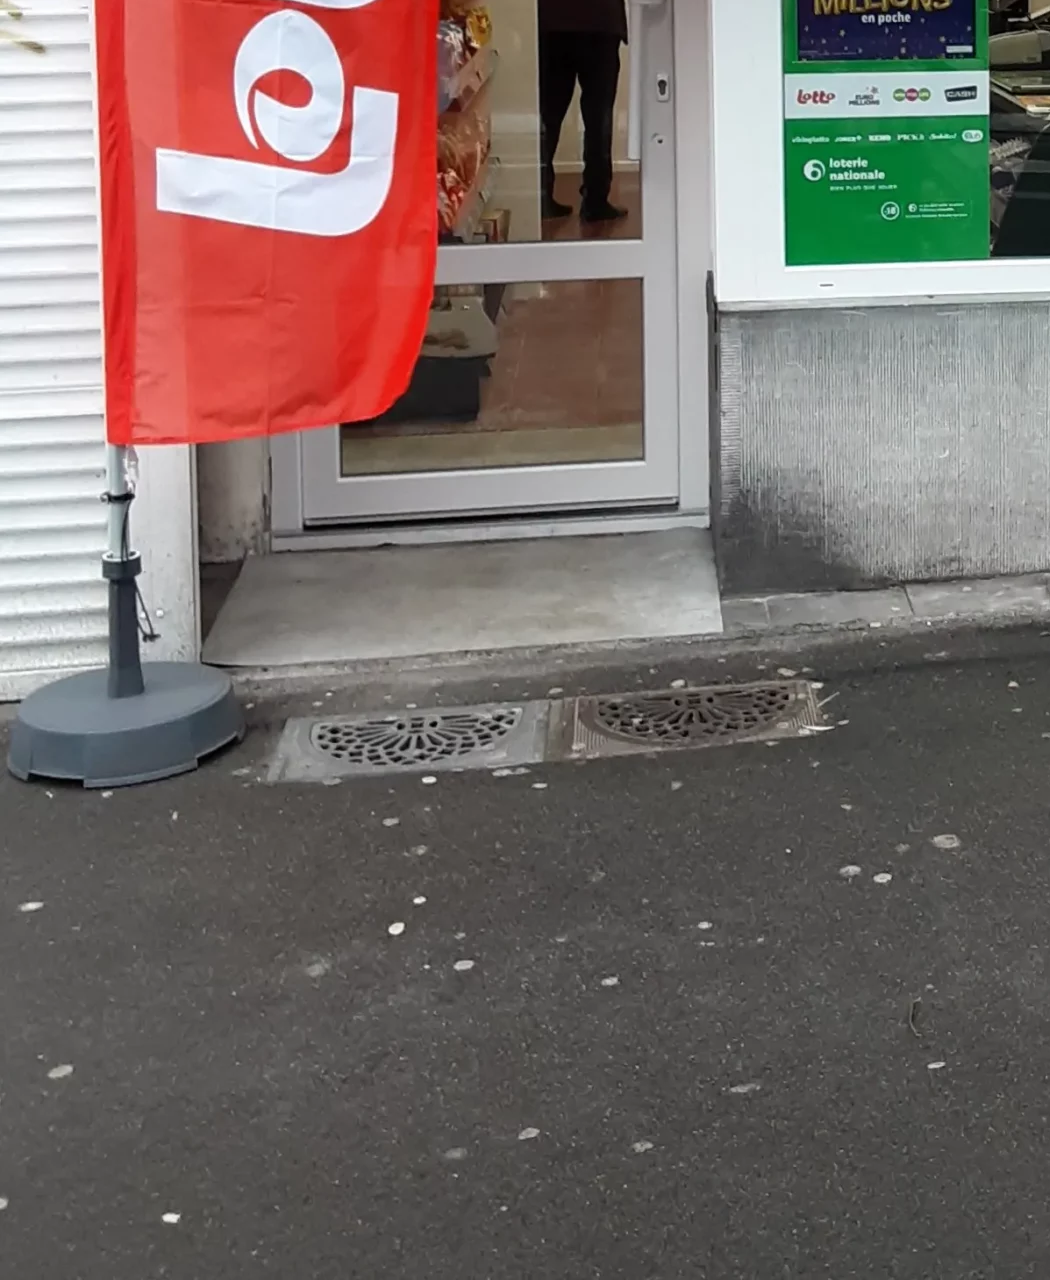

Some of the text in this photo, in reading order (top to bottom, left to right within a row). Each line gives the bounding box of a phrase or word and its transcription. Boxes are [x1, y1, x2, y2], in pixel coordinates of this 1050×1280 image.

[861, 11, 912, 26] en poche
[829, 158, 869, 169] loterie
[829, 169, 886, 181] nationale
